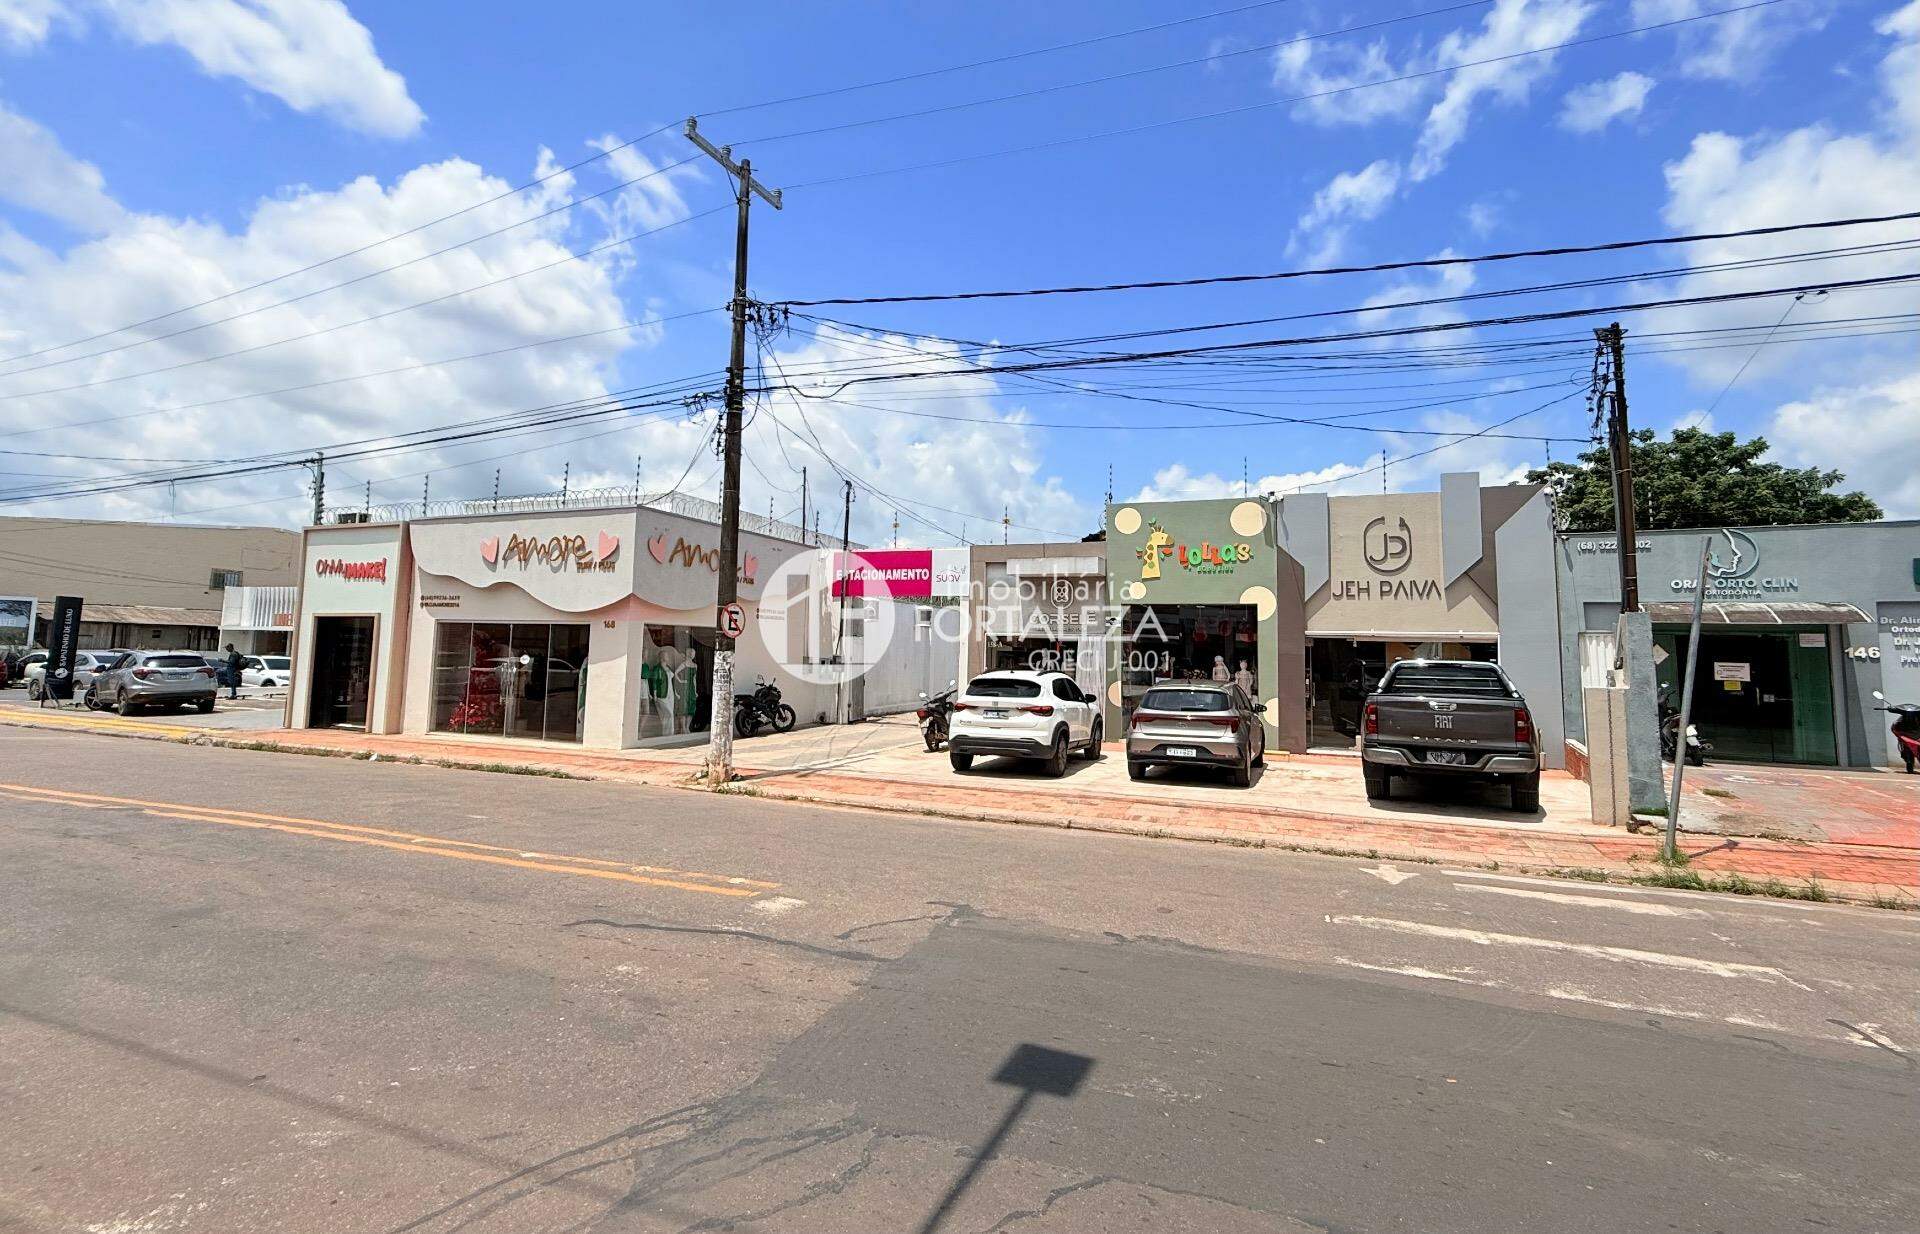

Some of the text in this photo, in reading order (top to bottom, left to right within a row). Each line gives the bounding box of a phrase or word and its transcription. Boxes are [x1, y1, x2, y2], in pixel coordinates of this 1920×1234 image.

[502, 533, 593, 562] Amore
[1577, 542, 1596, 551] (68)
[836, 567, 930, 582] ETACIONAMENTO
[1715, 578, 1757, 589] ORTO
[1761, 577, 1799, 588] CLIN
[1332, 579, 1442, 600] JEH PAIVA
[603, 621, 616, 629] 168
[1880, 616, 1896, 624] Dr.
[1894, 637, 1911, 646] Dr.
[1844, 646, 1881, 659] 146
[1433, 714, 1454, 729] FIAT
